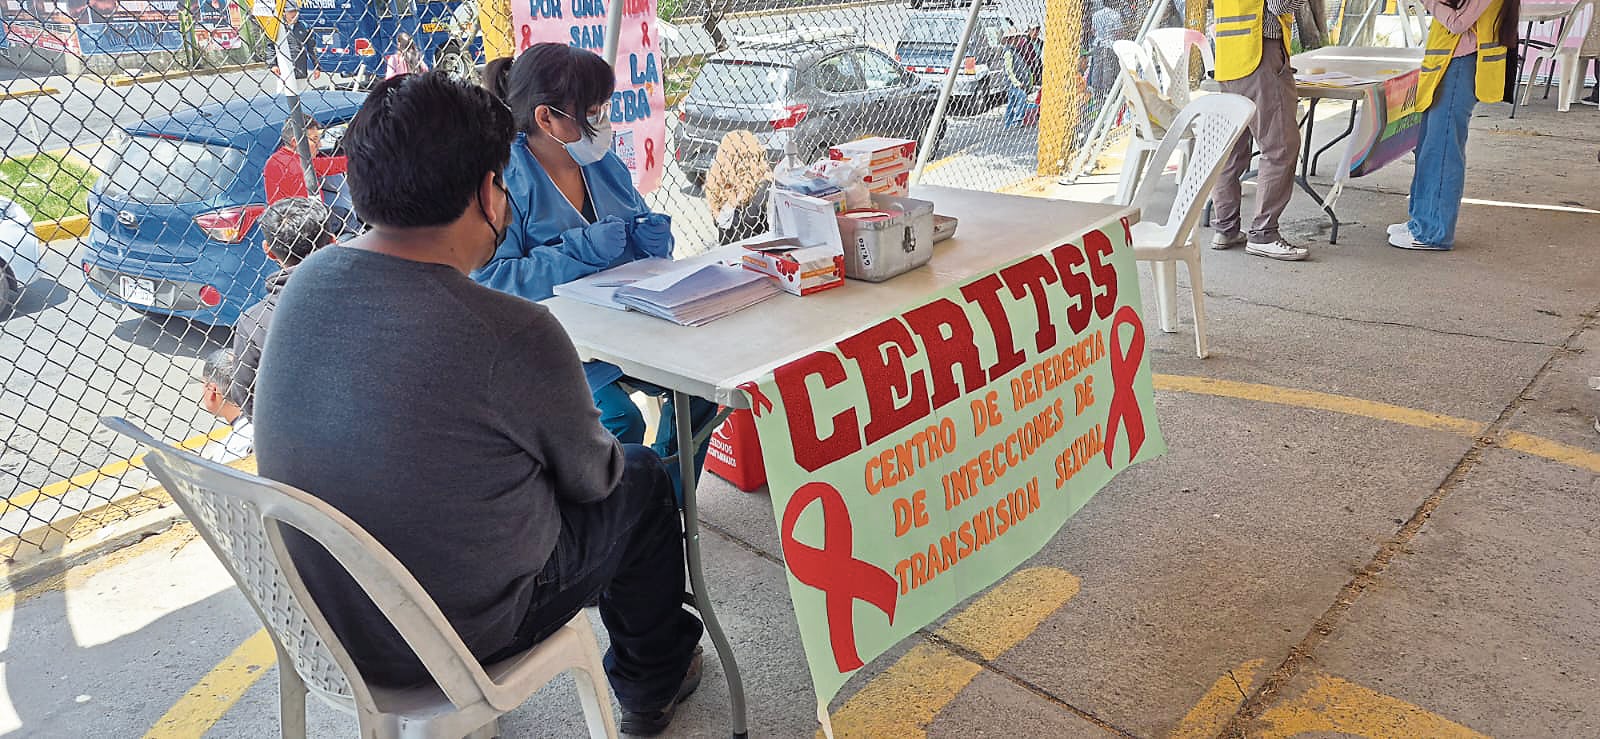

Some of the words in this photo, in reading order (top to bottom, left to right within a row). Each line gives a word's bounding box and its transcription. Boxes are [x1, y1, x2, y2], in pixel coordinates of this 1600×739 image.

[530, 0, 563, 19] POR
[572, 0, 605, 18] UNA
[622, 0, 651, 16] IDA
[569, 25, 607, 48] SAN
[610, 88, 651, 122] EBA
[630, 53, 659, 85] LA
[773, 229, 1118, 473] CERITSS
[865, 417, 957, 495] CENTRO
[971, 390, 1003, 437] DE
[1011, 329, 1106, 412] REFERENCIA
[893, 489, 930, 537] DE
[942, 397, 1064, 511] INFECCIONES
[1074, 374, 1095, 417] DE
[894, 476, 1041, 595] TRANSMISION
[1055, 423, 1106, 489] SEXUAL
